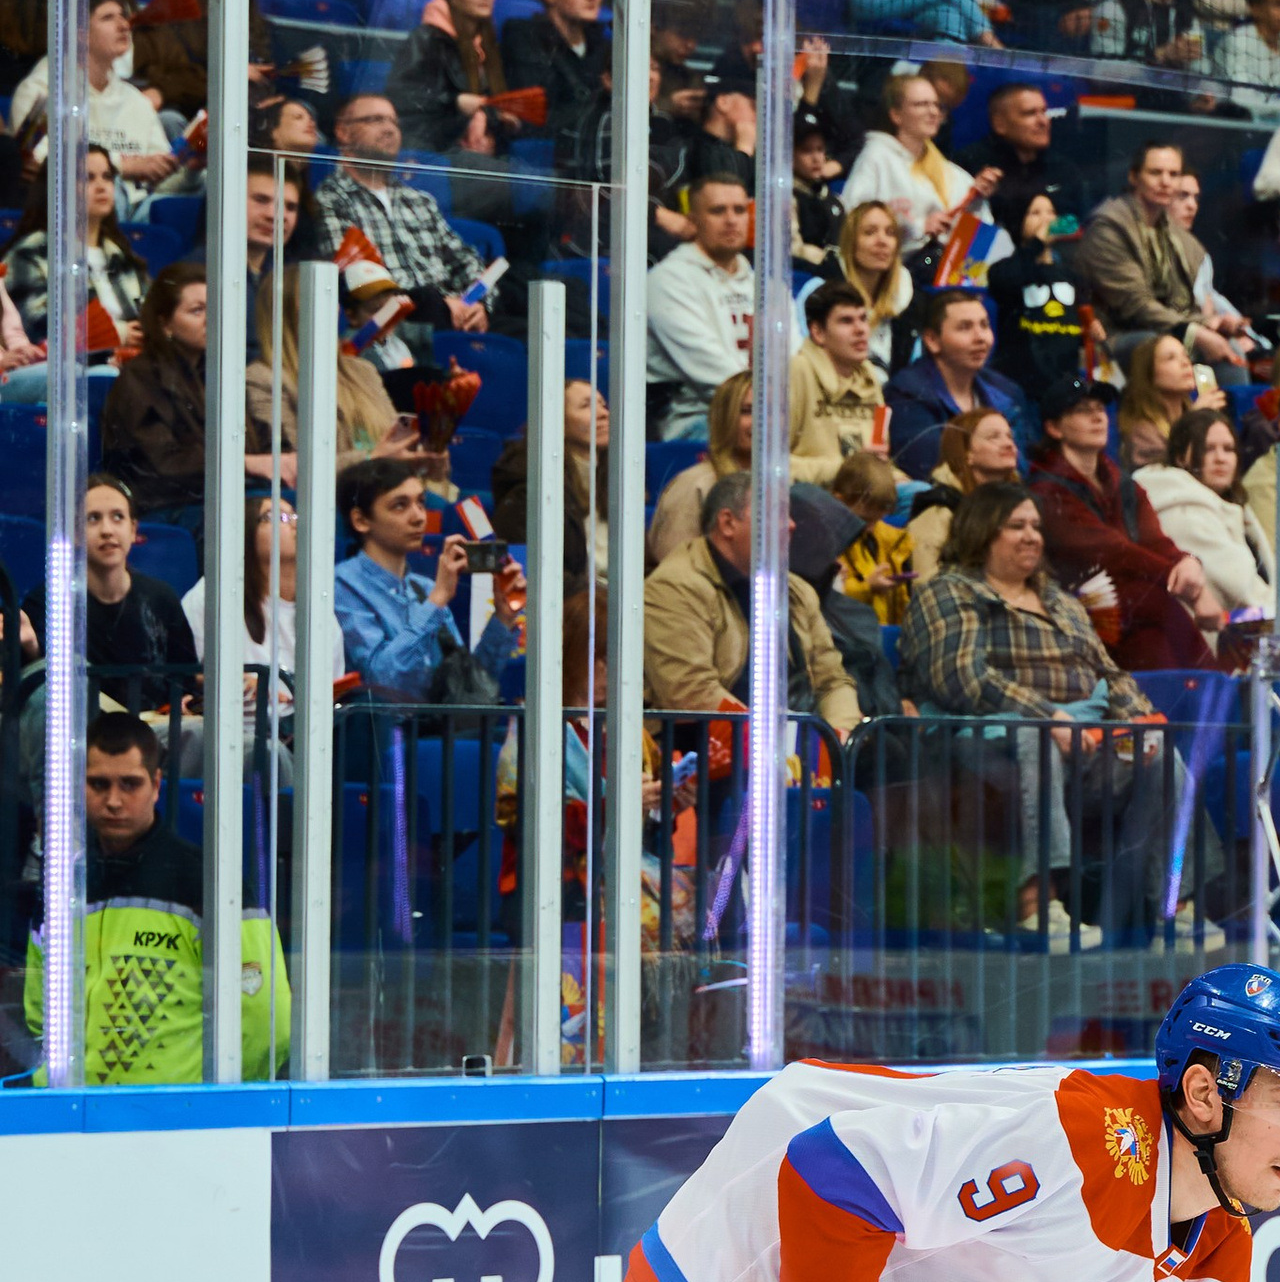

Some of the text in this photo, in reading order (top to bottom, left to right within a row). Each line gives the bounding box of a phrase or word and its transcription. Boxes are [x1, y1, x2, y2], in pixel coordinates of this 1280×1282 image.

[134, 931, 181, 950] КРУК
[1192, 1022, 1232, 1041] CCM
[957, 1159, 1041, 1223] 9
